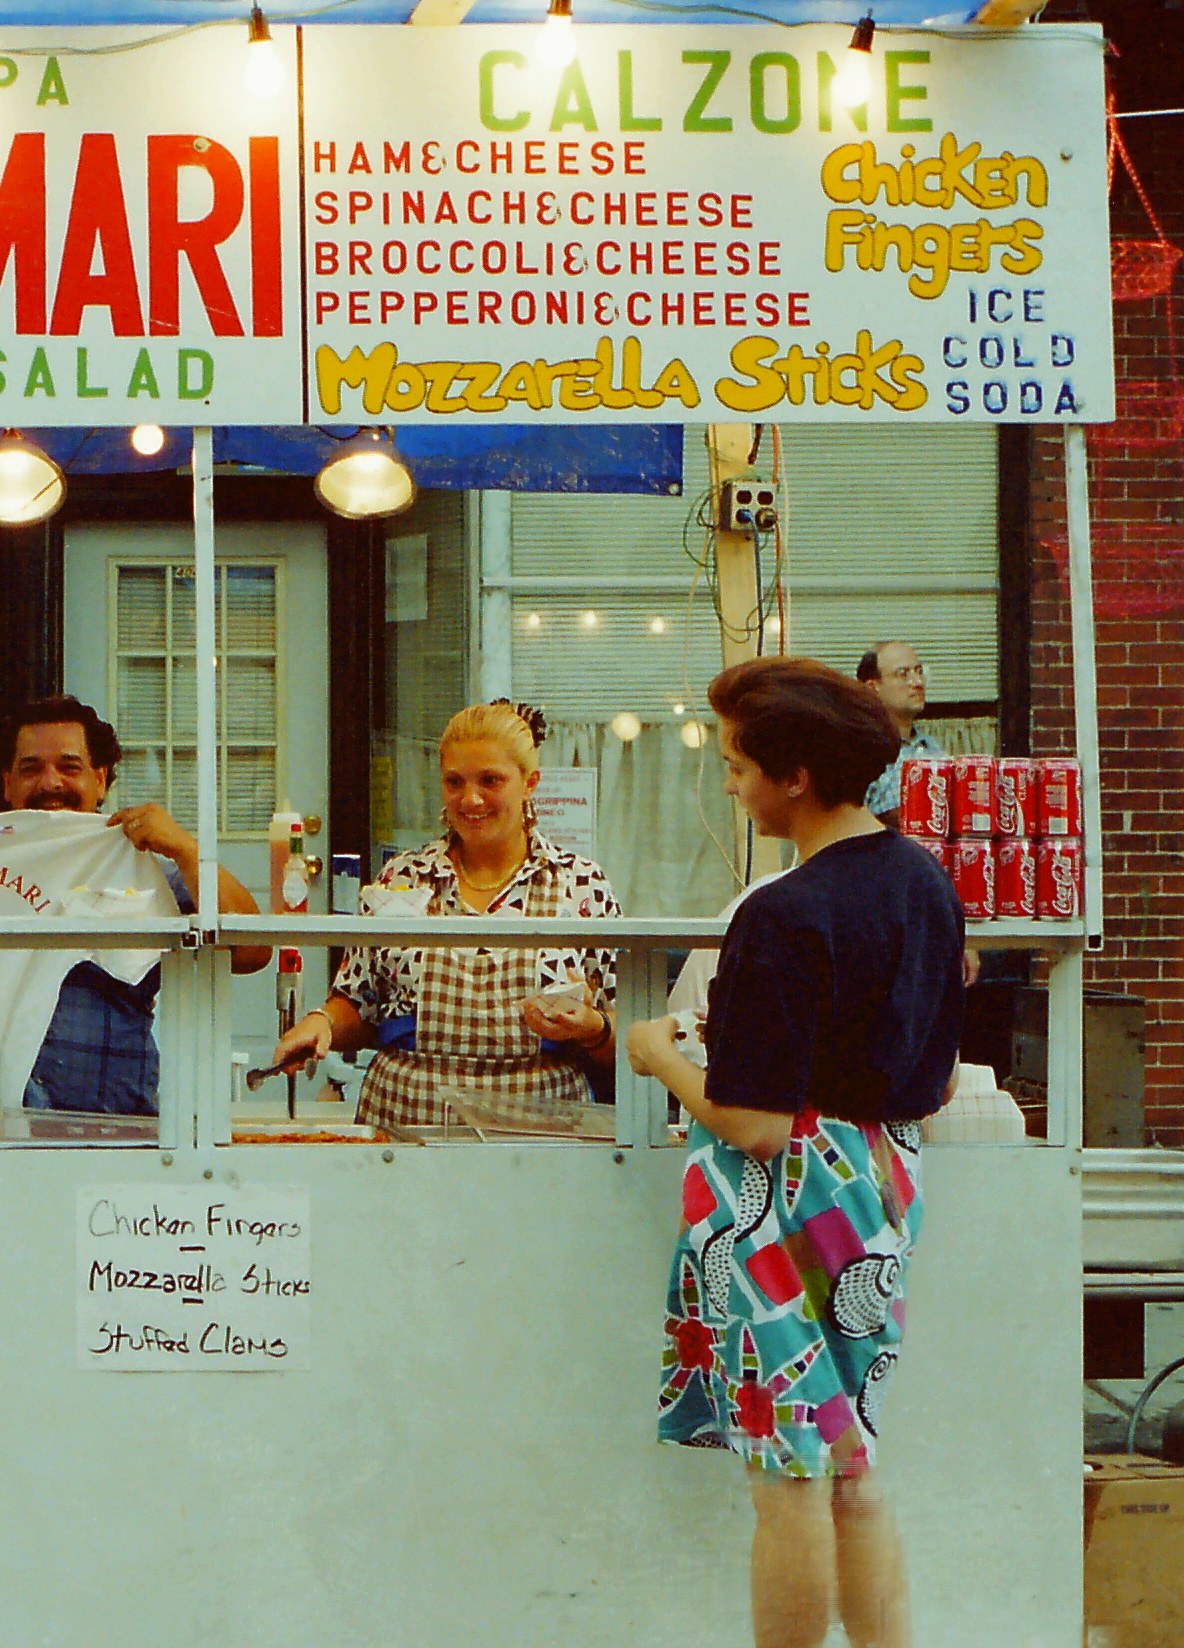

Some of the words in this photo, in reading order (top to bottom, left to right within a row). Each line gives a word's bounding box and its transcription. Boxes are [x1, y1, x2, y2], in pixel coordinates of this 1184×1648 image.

[479, 49, 933, 135] CALZONE
[969, 288, 1046, 323] ICE
[942, 334, 1076, 369] COLD
[944, 380, 1079, 415] SODA
[926, 775, 947, 835] Coca-Cola
[995, 775, 1016, 834] Coca-Cola
[1051, 854, 1073, 914] Coca-Cola
[88, 1200, 195, 1237] Chicken
[207, 1203, 301, 1246] Fingers
[88, 1260, 227, 1294] Mozzarella
[240, 1263, 310, 1297] Sticks
[89, 1322, 190, 1353] Stuffed
